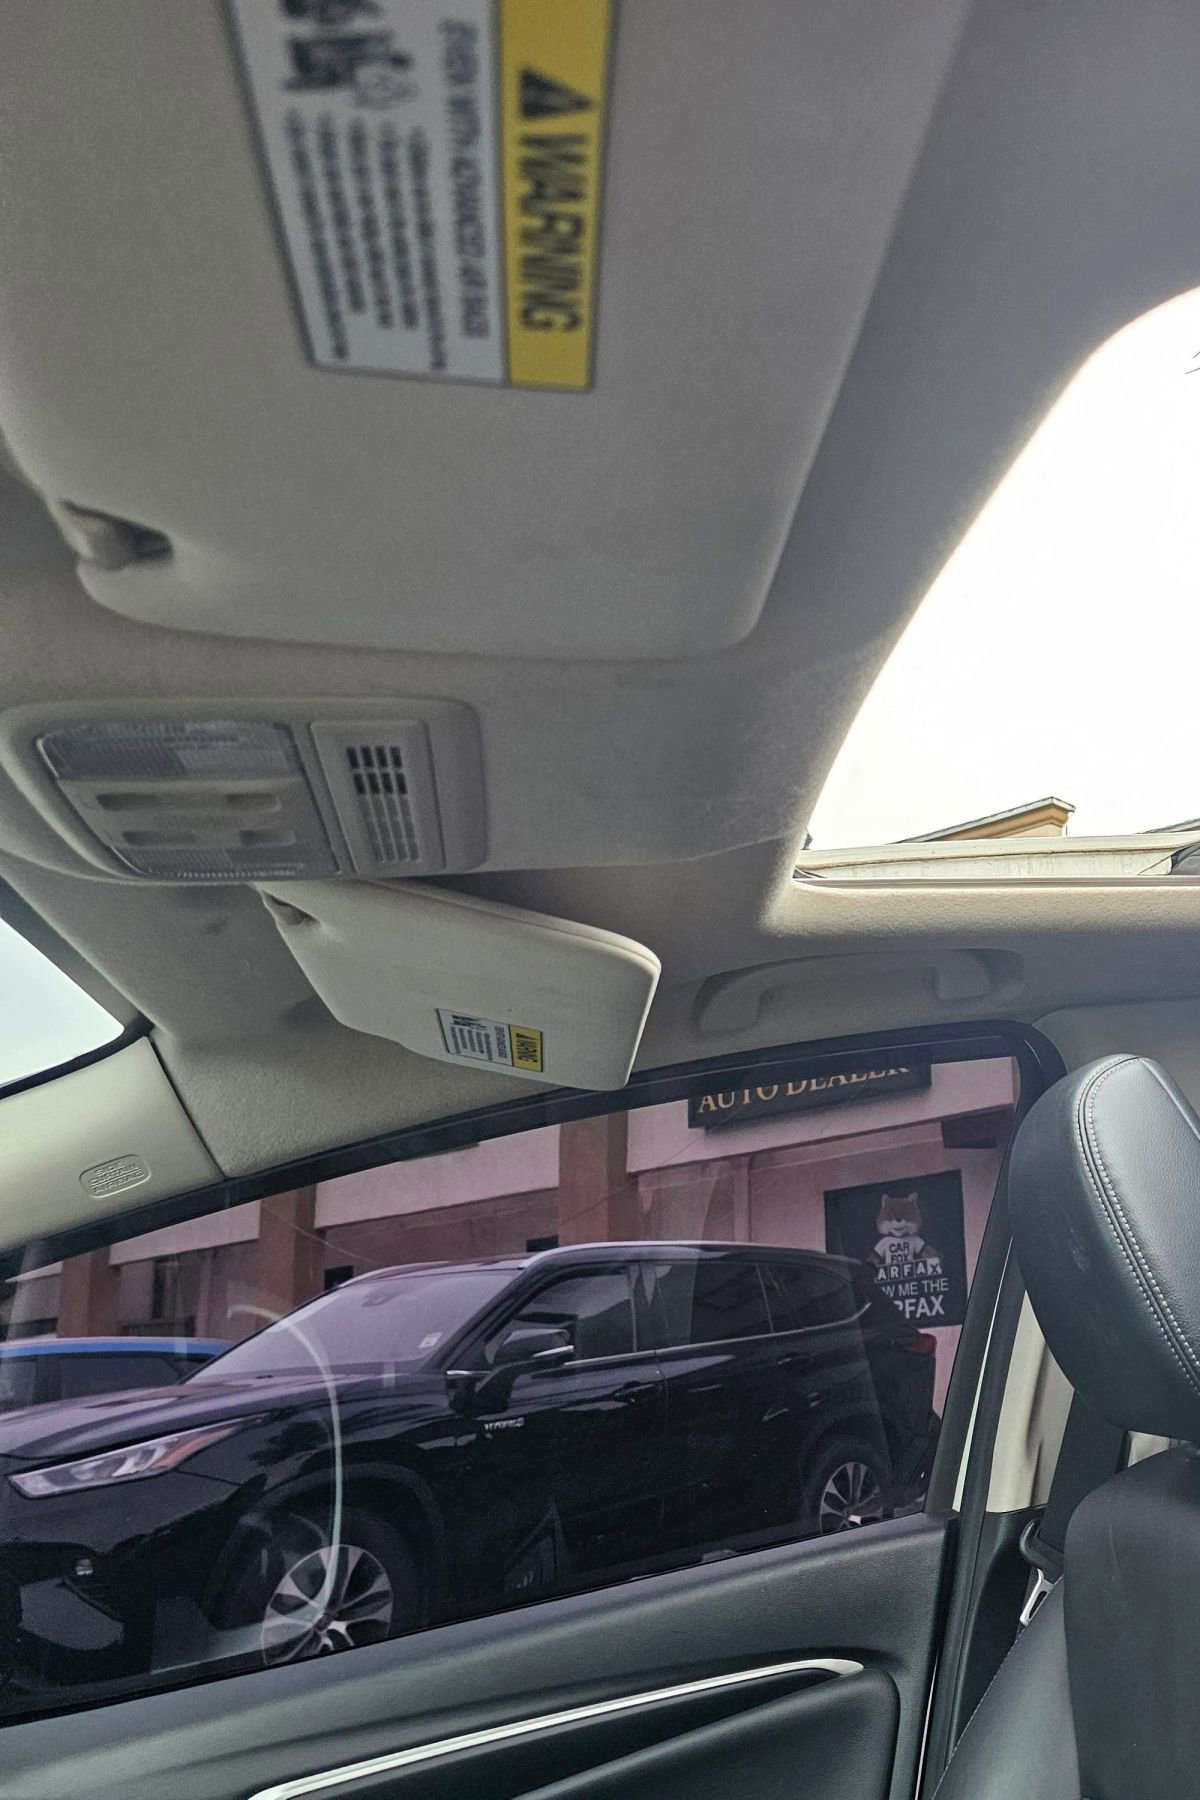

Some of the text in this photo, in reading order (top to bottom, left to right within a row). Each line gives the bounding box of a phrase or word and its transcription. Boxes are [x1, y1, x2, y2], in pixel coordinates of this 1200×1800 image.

[519, 133, 588, 332] WARNING
[699, 1067, 909, 1113] AUTO DEA
[889, 1241, 910, 1254] CAR
[891, 1253, 909, 1264] FOX
[877, 1261, 943, 1281] ARFAX
[898, 1281, 919, 1297] ME
[921, 1277, 950, 1294] THE
[893, 1294, 945, 1320] FAX
